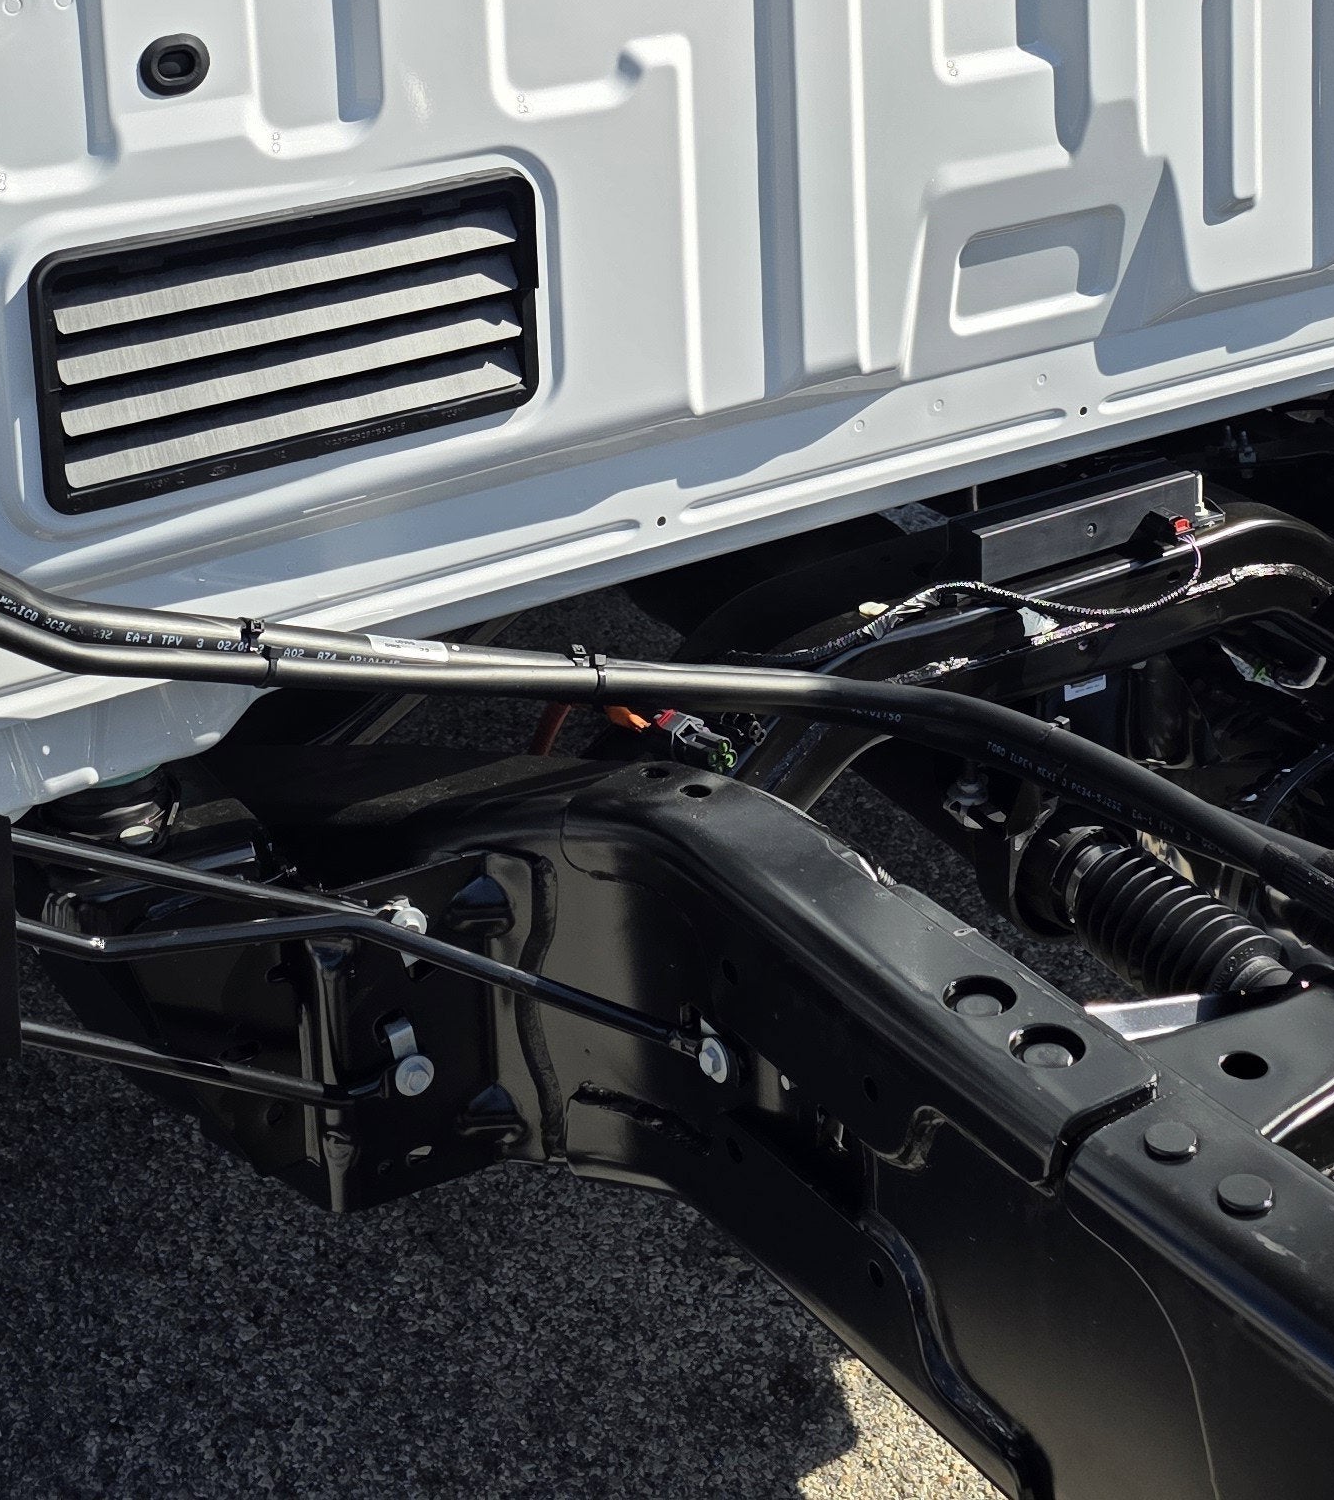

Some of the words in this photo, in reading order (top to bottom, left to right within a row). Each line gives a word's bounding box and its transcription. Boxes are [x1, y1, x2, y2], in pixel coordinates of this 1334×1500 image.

[125, 631, 153, 644] EA-1
[161, 634, 183, 647] TPV
[196, 637, 204, 649] 3
[283, 647, 305, 658] A02
[1036, 767, 1067, 788] MEXIO
